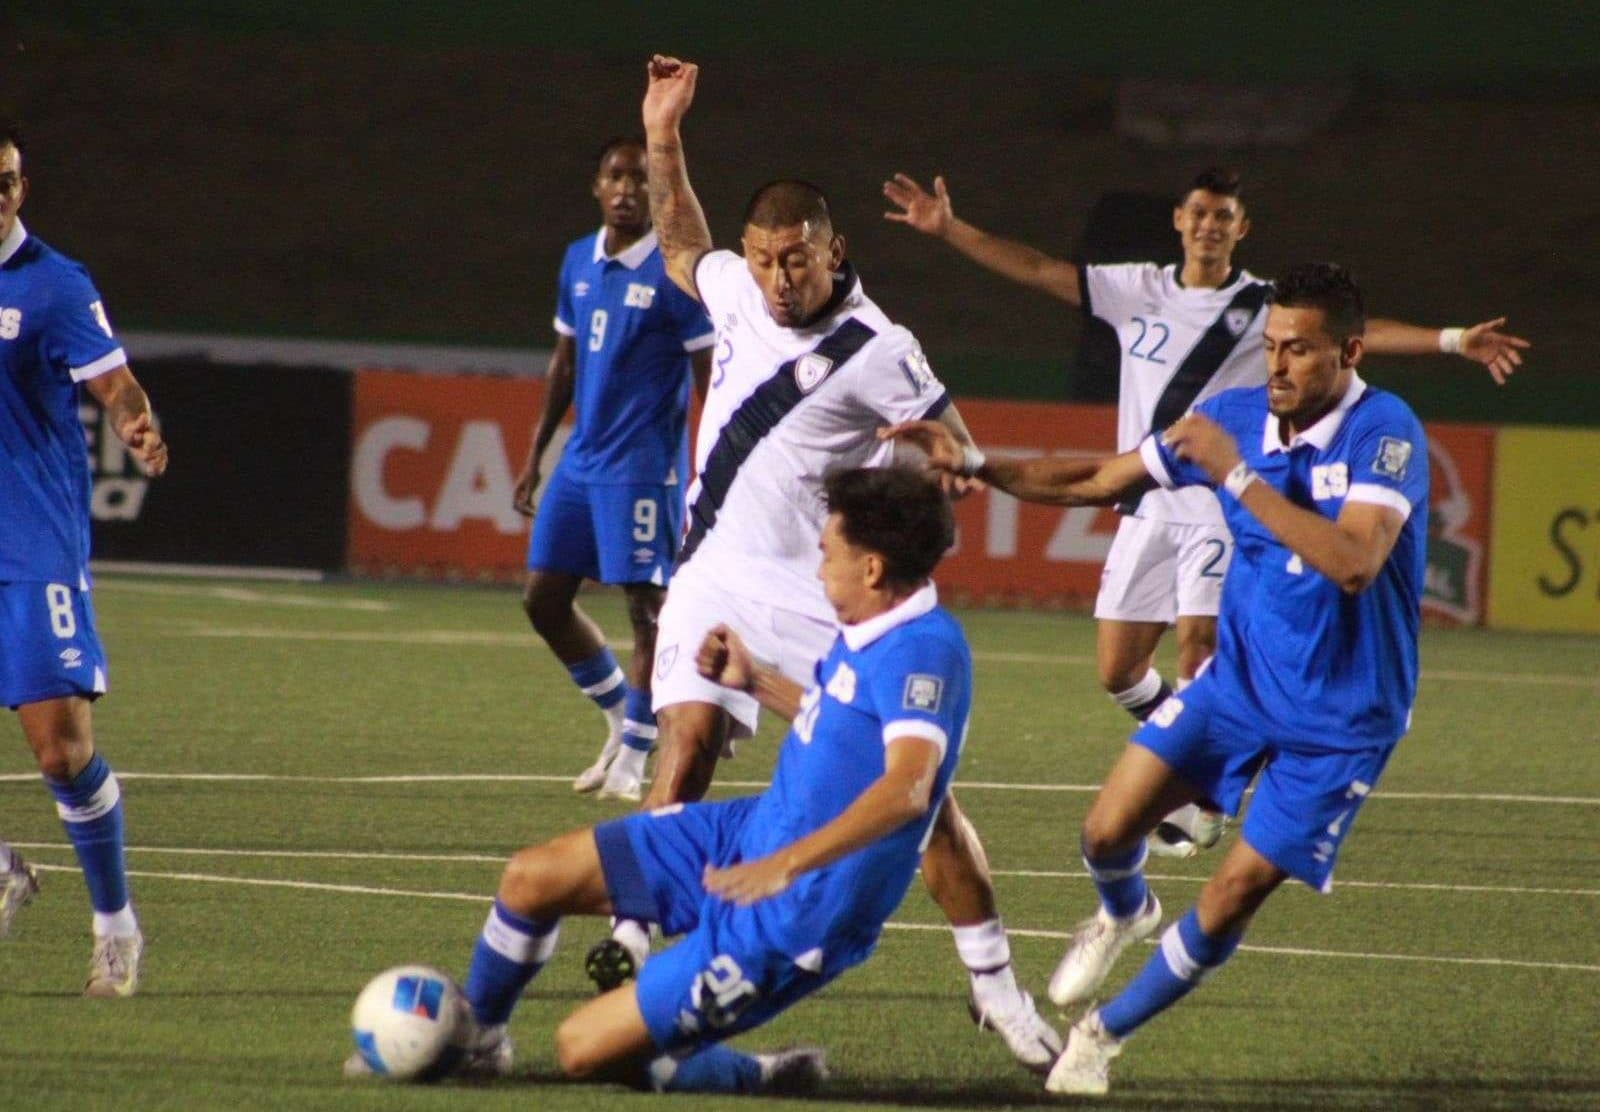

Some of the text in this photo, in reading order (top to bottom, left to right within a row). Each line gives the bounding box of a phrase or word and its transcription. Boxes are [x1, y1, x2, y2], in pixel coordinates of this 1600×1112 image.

[588, 309, 609, 352] 9
[1129, 317, 1170, 364] 22
[632, 499, 658, 542] 9
[46, 582, 76, 639] 8
